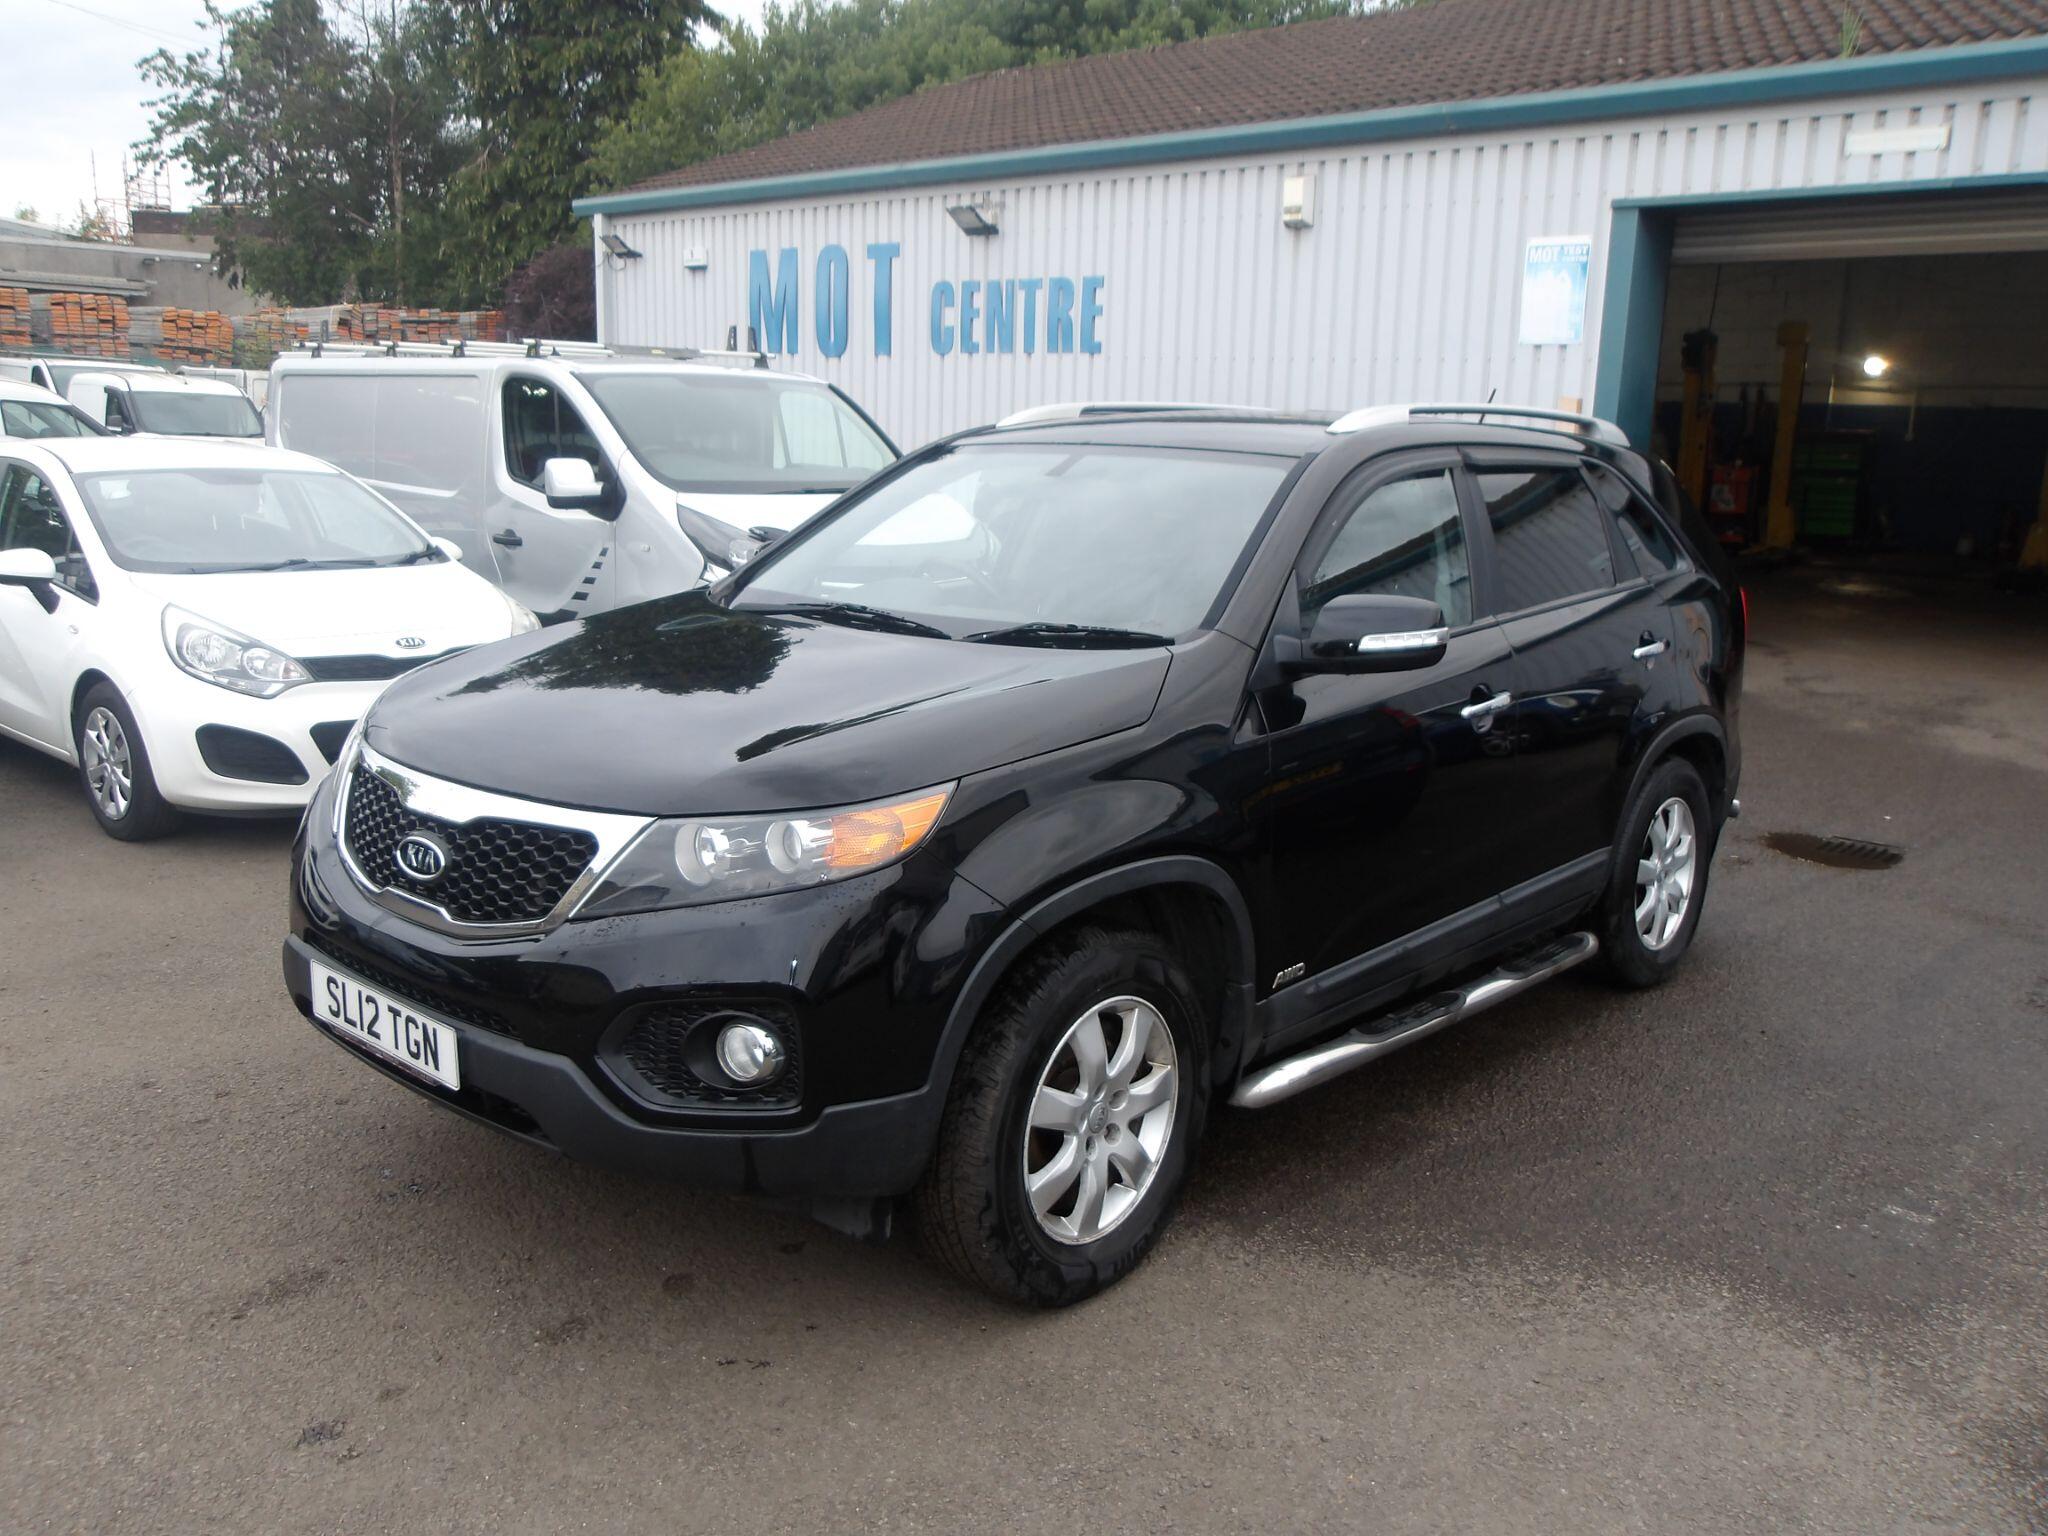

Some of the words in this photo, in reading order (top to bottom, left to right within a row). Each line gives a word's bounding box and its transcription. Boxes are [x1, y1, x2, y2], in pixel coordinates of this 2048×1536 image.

[1529, 246, 1560, 263] MOT
[750, 243, 900, 358] MOT
[931, 275, 1105, 355] CENTRE
[406, 842, 435, 873] KIA
[326, 975, 381, 1041] SL12
[387, 1004, 440, 1072] TGN
